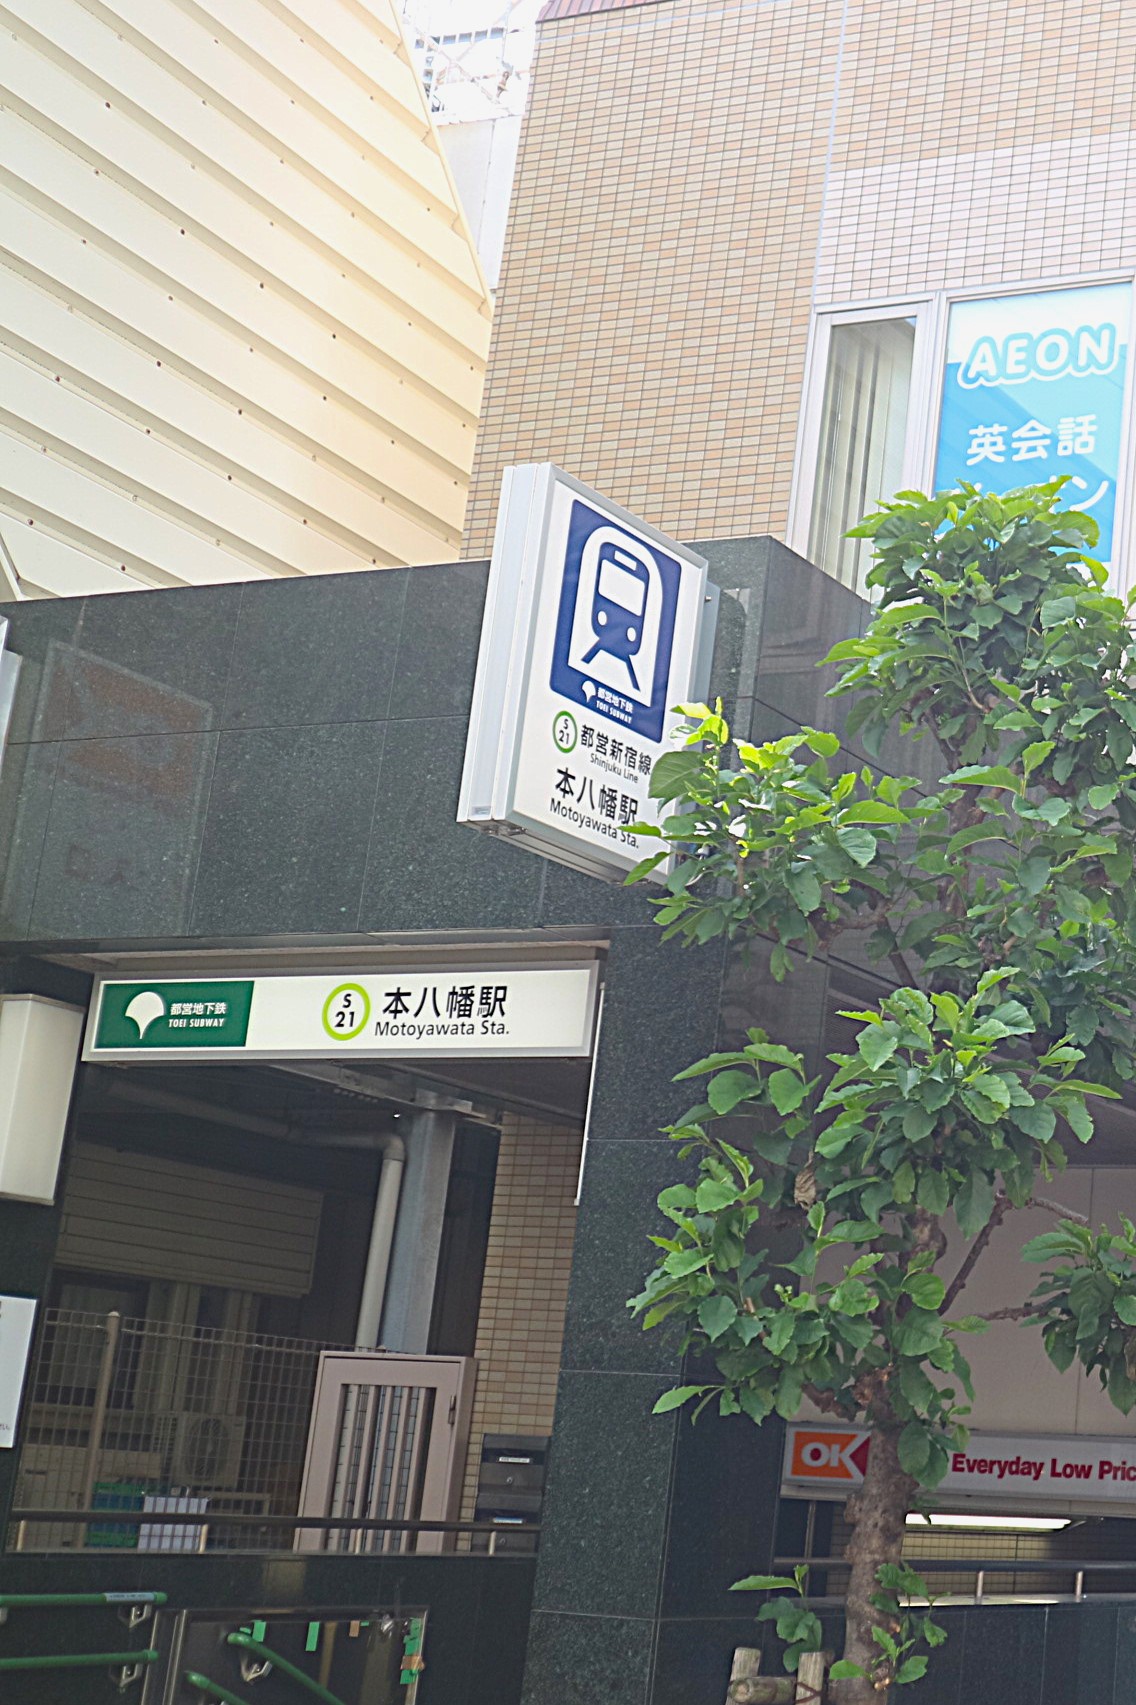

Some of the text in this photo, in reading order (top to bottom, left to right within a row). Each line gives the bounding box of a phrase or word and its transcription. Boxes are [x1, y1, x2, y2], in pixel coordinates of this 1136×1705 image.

[967, 329, 1110, 379] AEON
[965, 414, 1099, 466] 英会話
[596, 700, 633, 724] TOEI SUBWAY
[597, 687, 634, 714] 都営地下鉄
[558, 730, 570, 745] 21
[563, 718, 569, 730] S
[580, 724, 652, 775] 都営新宿線
[590, 753, 639, 784] Shinjuku Line
[555, 767, 639, 825] 本八幡駅
[549, 797, 618, 839] Motoyawata
[170, 1002, 227, 1016] 都営地下鉄
[342, 993, 352, 1008] S
[382, 985, 508, 1020] 本八幡駅
[168, 1018, 225, 1028] TOEI SUBWAY
[335, 1011, 355, 1028] 21
[374, 1019, 510, 1040] Motoyawata Sta.
[801, 1431, 869, 1477] OK
[951, 1452, 1045, 1481] Everyday
[1050, 1457, 1093, 1481] Low
